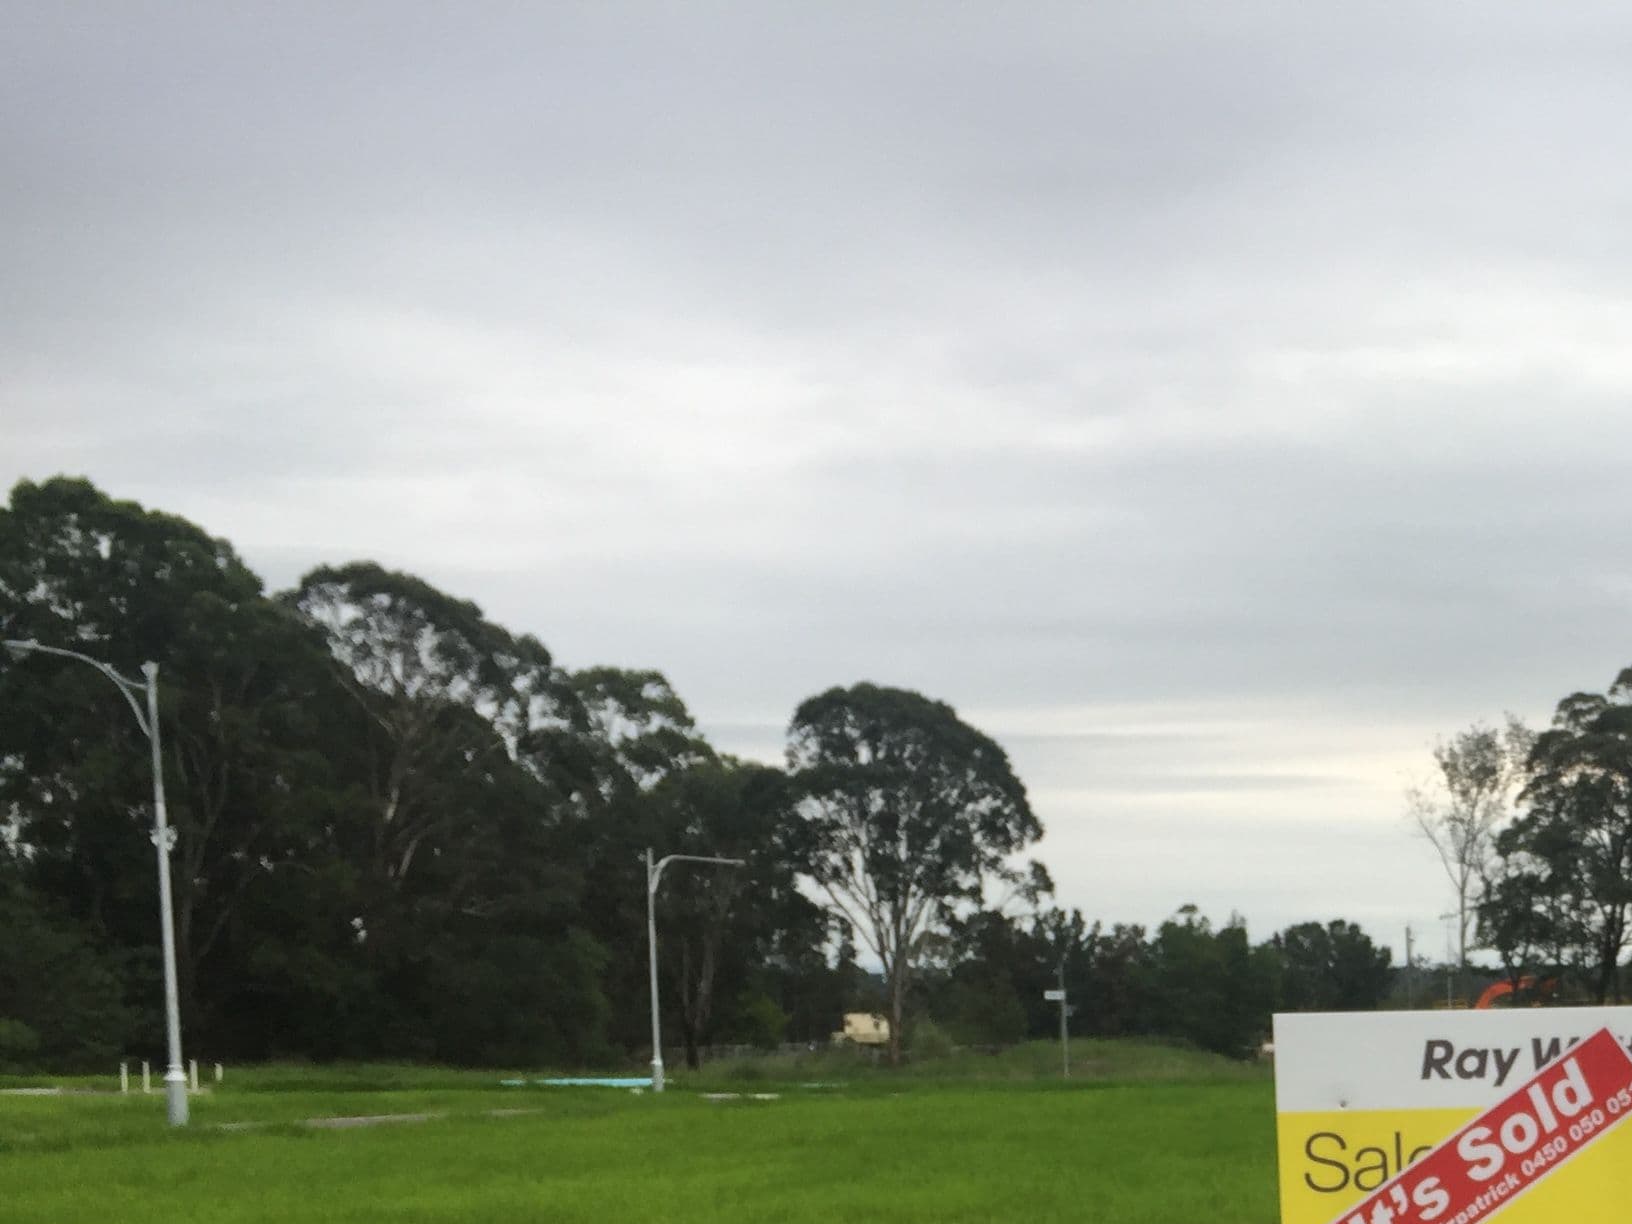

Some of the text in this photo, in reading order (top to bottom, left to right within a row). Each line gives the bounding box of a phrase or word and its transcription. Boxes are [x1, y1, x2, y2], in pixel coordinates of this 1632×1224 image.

[1421, 1038, 1521, 1087] Ray
[1457, 1057, 1595, 1182] Sold
[1521, 1134, 1568, 1177] 0450
[1569, 1108, 1605, 1142] 050
